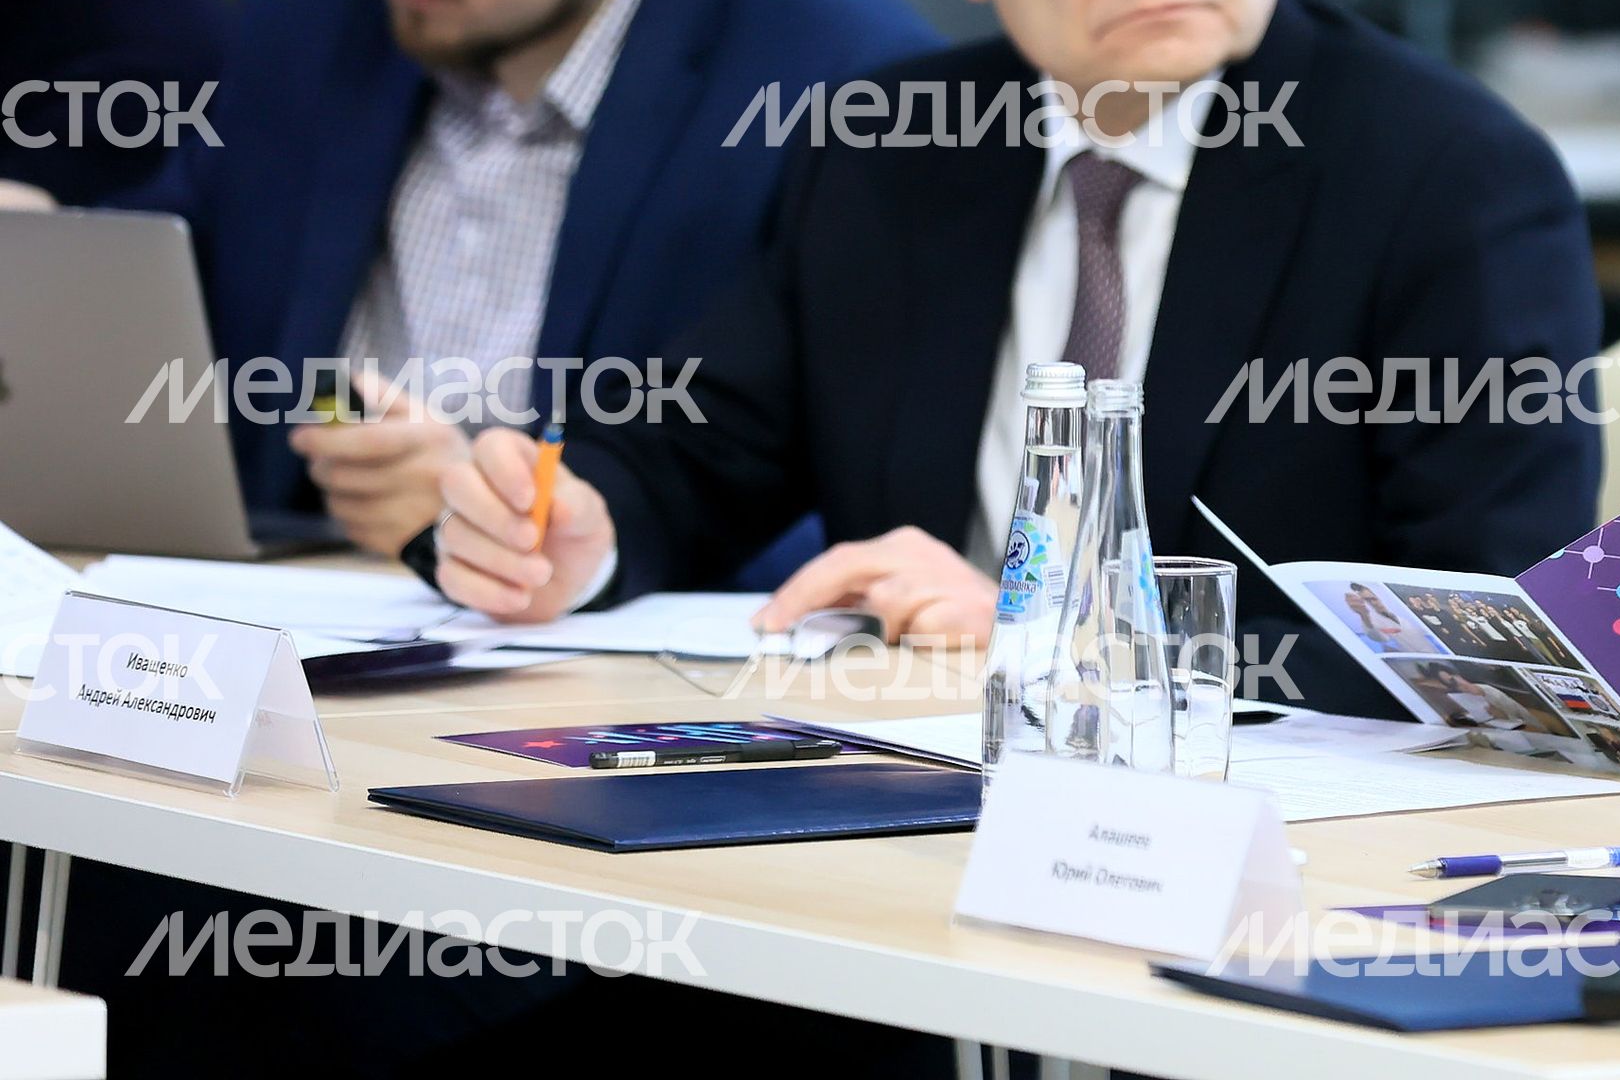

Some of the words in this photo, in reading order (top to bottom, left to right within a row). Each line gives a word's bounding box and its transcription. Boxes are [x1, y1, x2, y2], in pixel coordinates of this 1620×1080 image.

[126, 652, 188, 678] Иващенко
[77, 684, 120, 706] Андрей
[121, 691, 217, 723] Александрович
